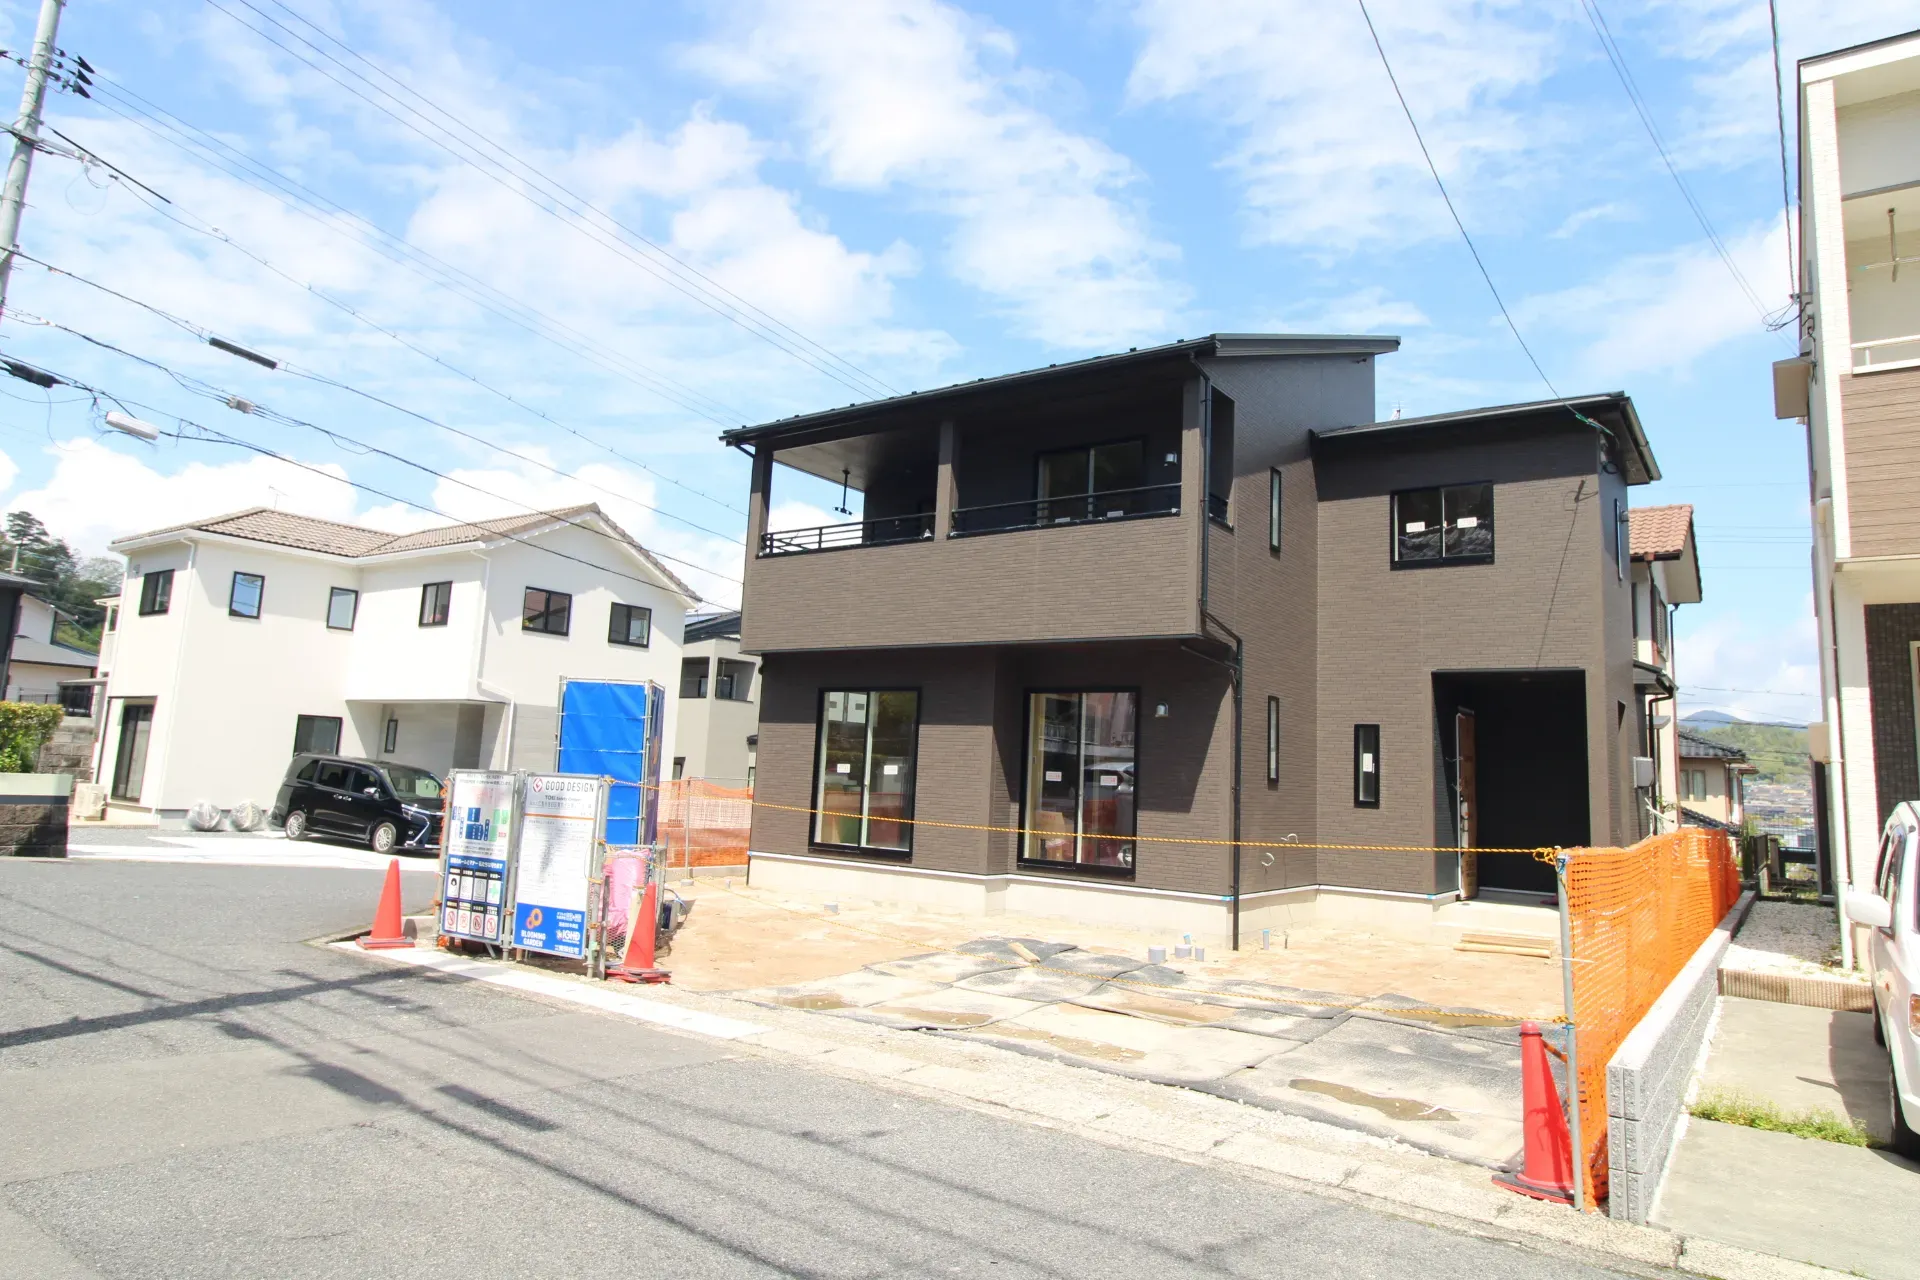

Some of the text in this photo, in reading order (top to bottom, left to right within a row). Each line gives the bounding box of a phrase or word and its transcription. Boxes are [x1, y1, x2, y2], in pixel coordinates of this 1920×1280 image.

[545, 781, 595, 793] GOOD DESIGN
[521, 929, 546, 940] BLOOMING
[523, 938, 543, 947] GARDEN
